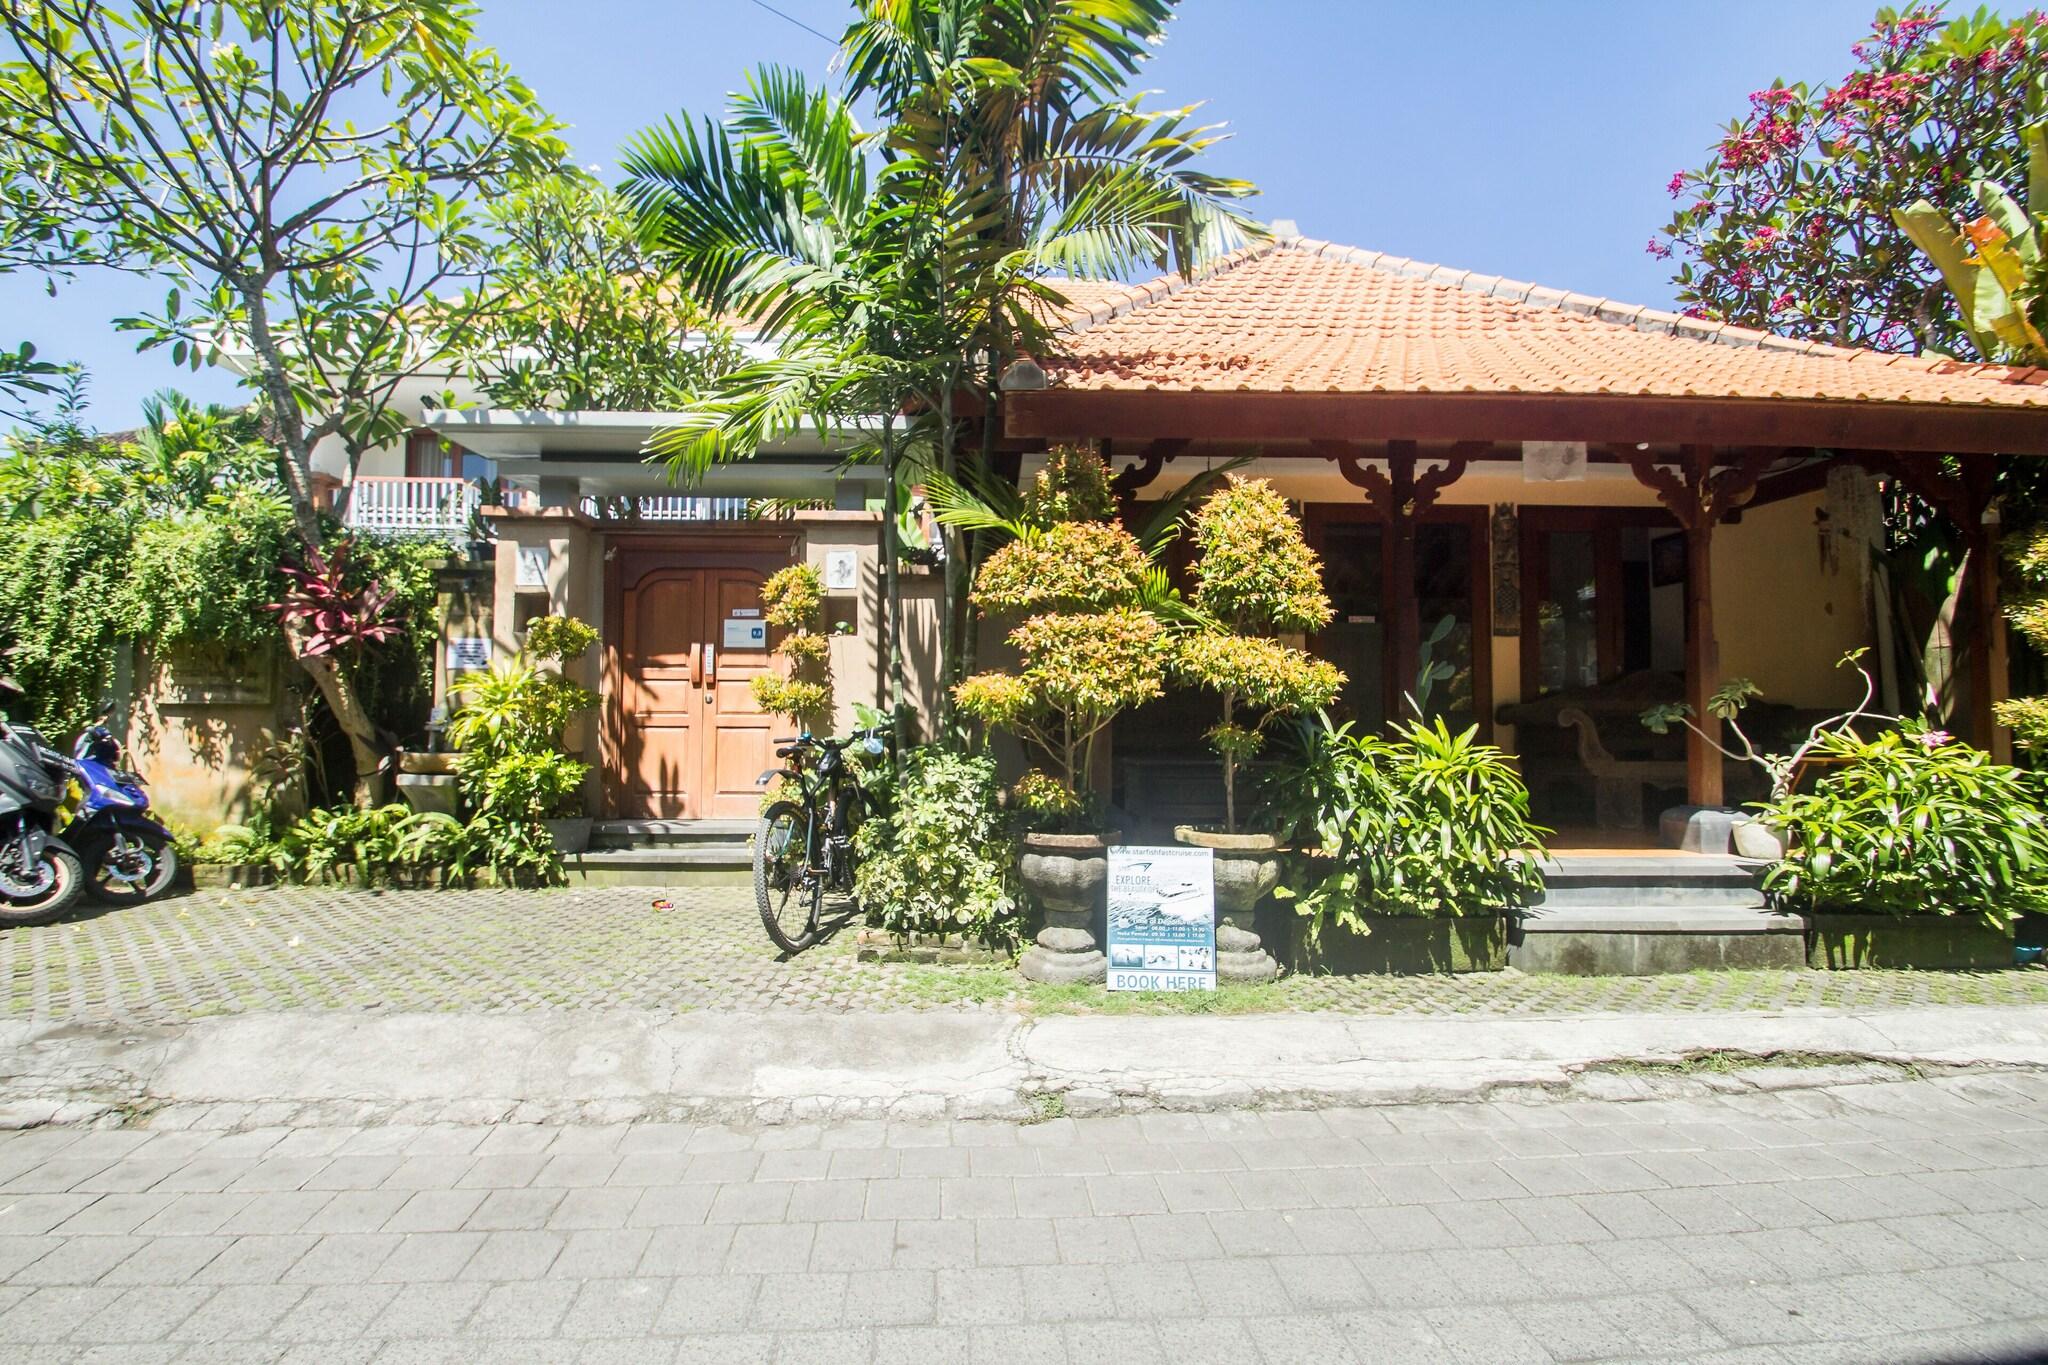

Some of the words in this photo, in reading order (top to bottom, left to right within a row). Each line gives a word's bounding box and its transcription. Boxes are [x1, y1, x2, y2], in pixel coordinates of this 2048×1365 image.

[1110, 847, 1209, 857] www.starfishfastcruise.com
[1116, 875, 1151, 885] EXPLORE
[1117, 975, 1160, 989] BOOK
